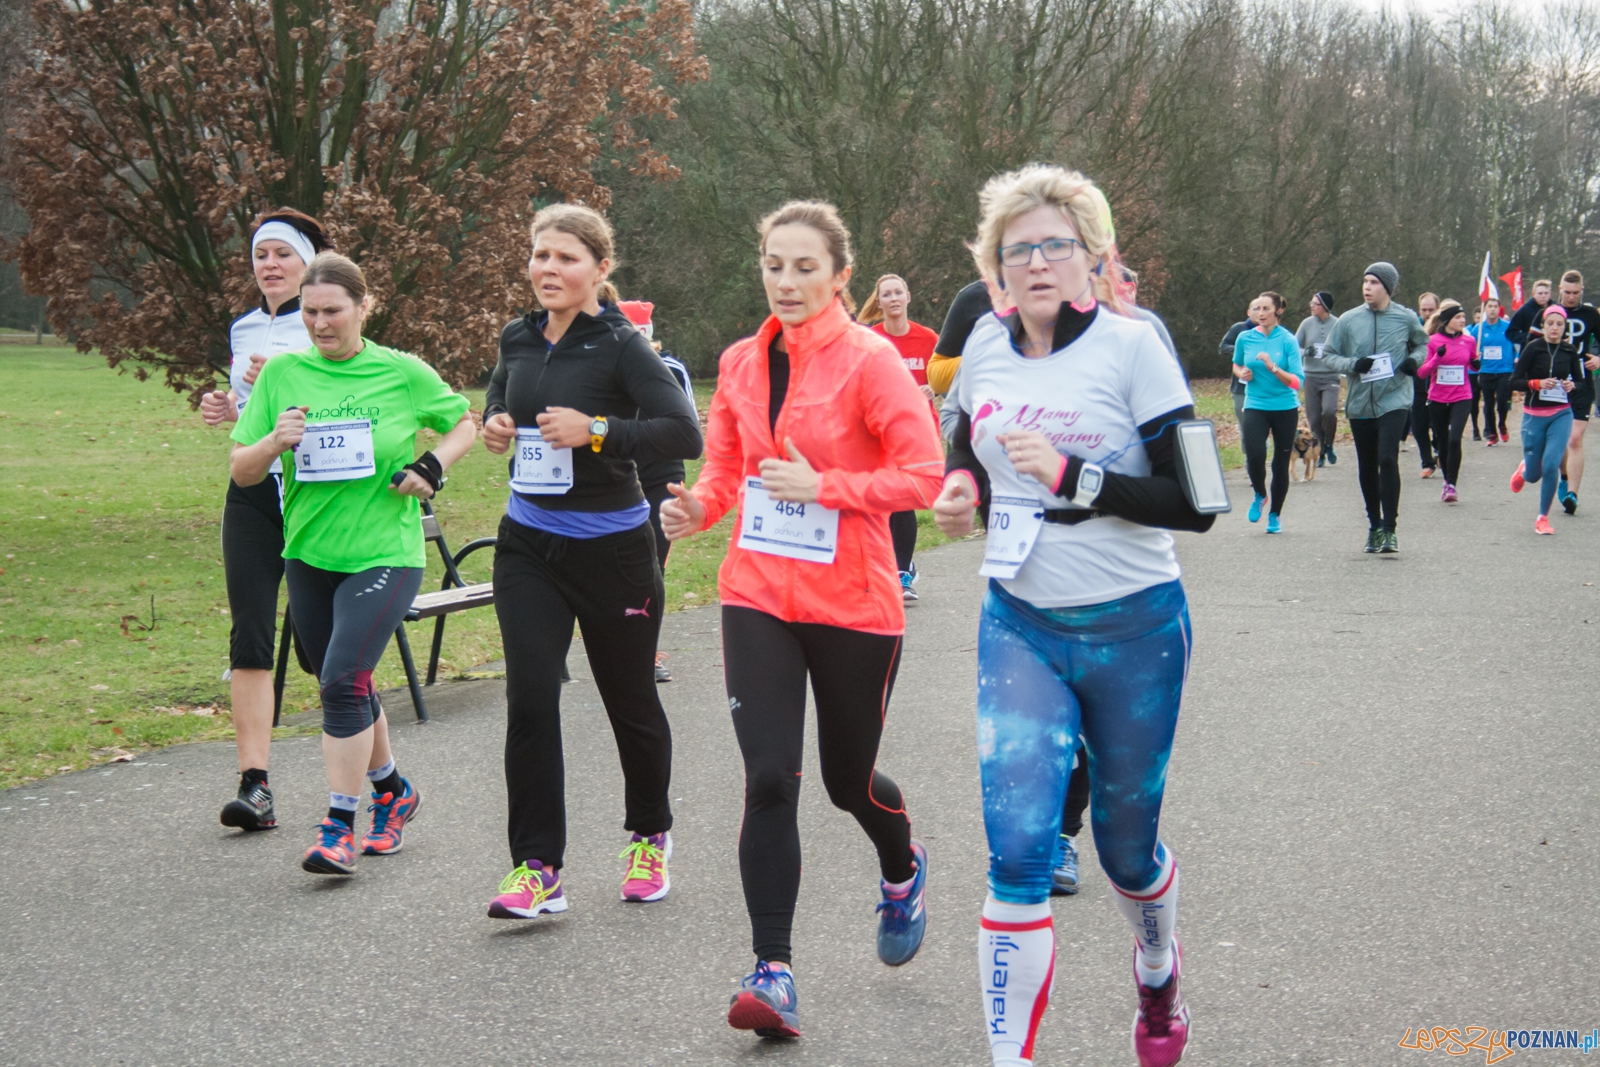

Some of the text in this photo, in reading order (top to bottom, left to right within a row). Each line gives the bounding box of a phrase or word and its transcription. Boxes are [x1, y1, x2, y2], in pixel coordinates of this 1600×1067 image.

[1003, 404, 1083, 428] Mamy
[319, 435, 345, 449] 122
[522, 446, 542, 460] 855
[775, 500, 806, 518] 464
